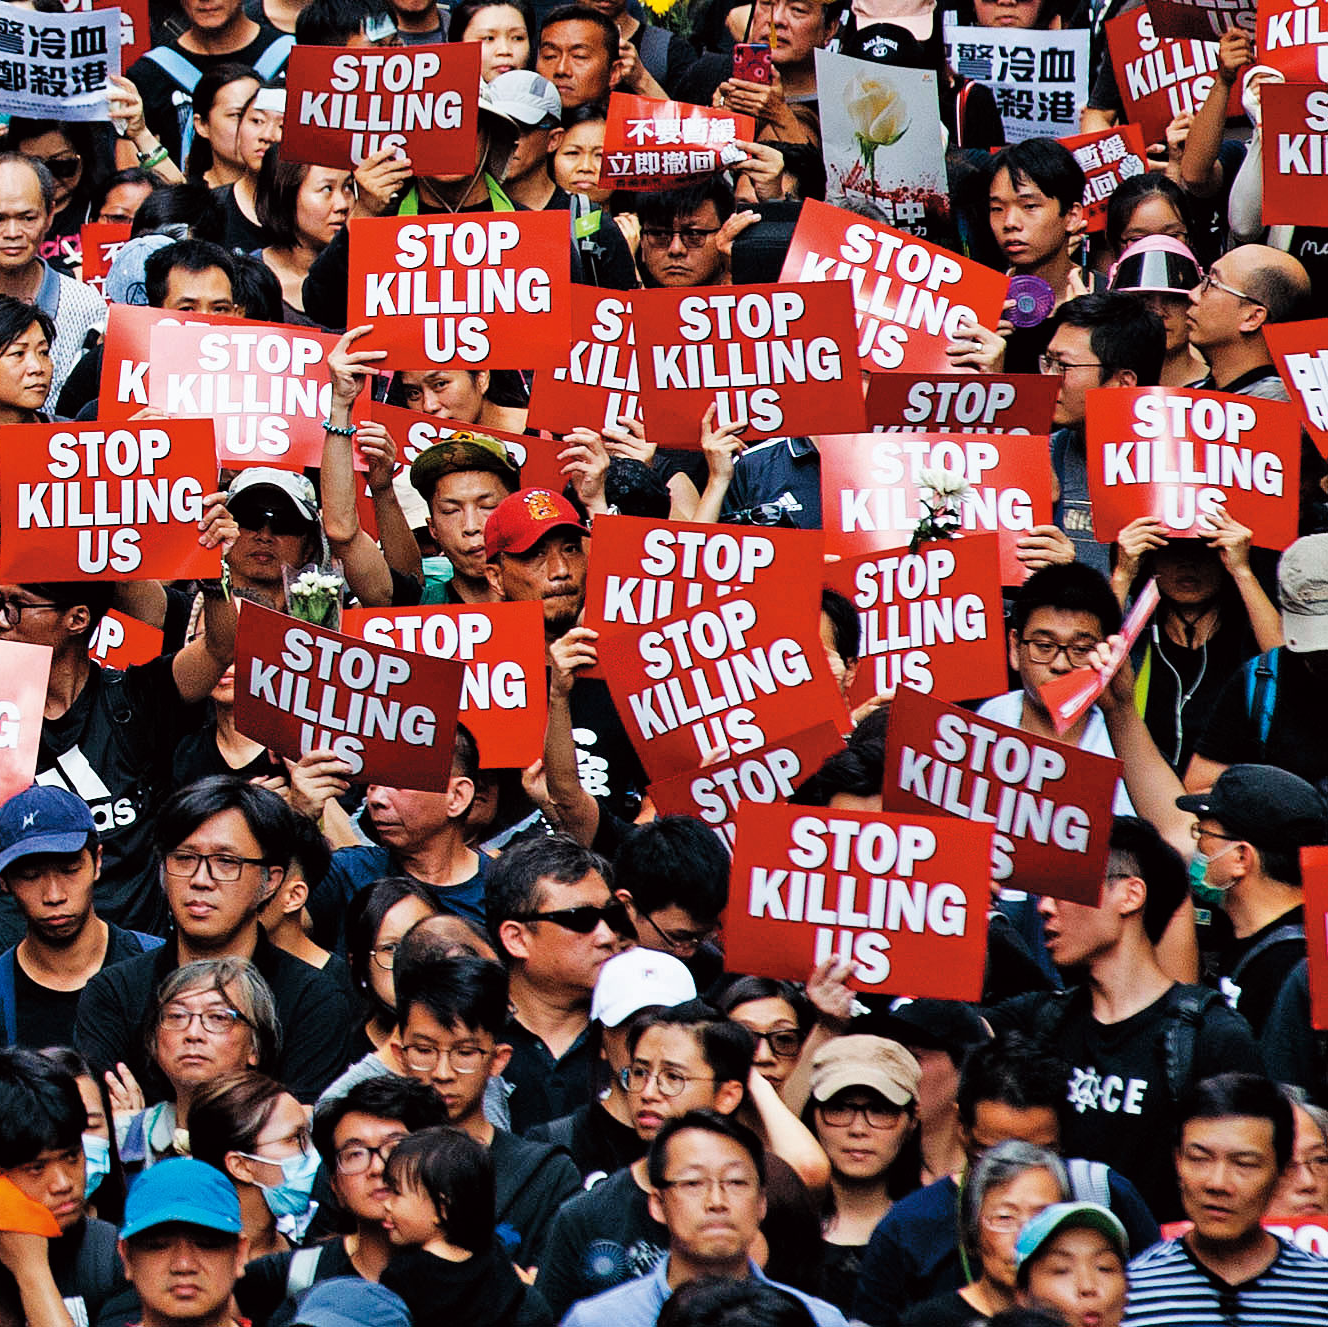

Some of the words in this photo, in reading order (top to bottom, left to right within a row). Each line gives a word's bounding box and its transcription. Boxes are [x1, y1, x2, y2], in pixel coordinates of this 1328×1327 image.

[945, 43, 1076, 83] 警冷血
[997, 88, 1075, 123] 殺港
[607, 150, 716, 176] 立即撤回
[395, 223, 519, 268] STOP
[365, 268, 551, 315] KILLING
[423, 317, 489, 363] US
[1131, 396, 1256, 445] STOP
[47, 432, 171, 479] STOP
[1104, 442, 1284, 497] KILLING
[19, 478, 203, 527] KILLING
[1162, 487, 1228, 531] US
[77, 529, 141, 574] US
[281, 627, 411, 697] STOP
[639, 597, 758, 680] STOP
[248, 655, 437, 747] KILLING
[628, 638, 812, 741] KILLING
[300, 722, 365, 775] US
[694, 708, 765, 763] US
[787, 817, 936, 876] STOP
[748, 871, 967, 936] KILLING
[815, 928, 891, 983] US
